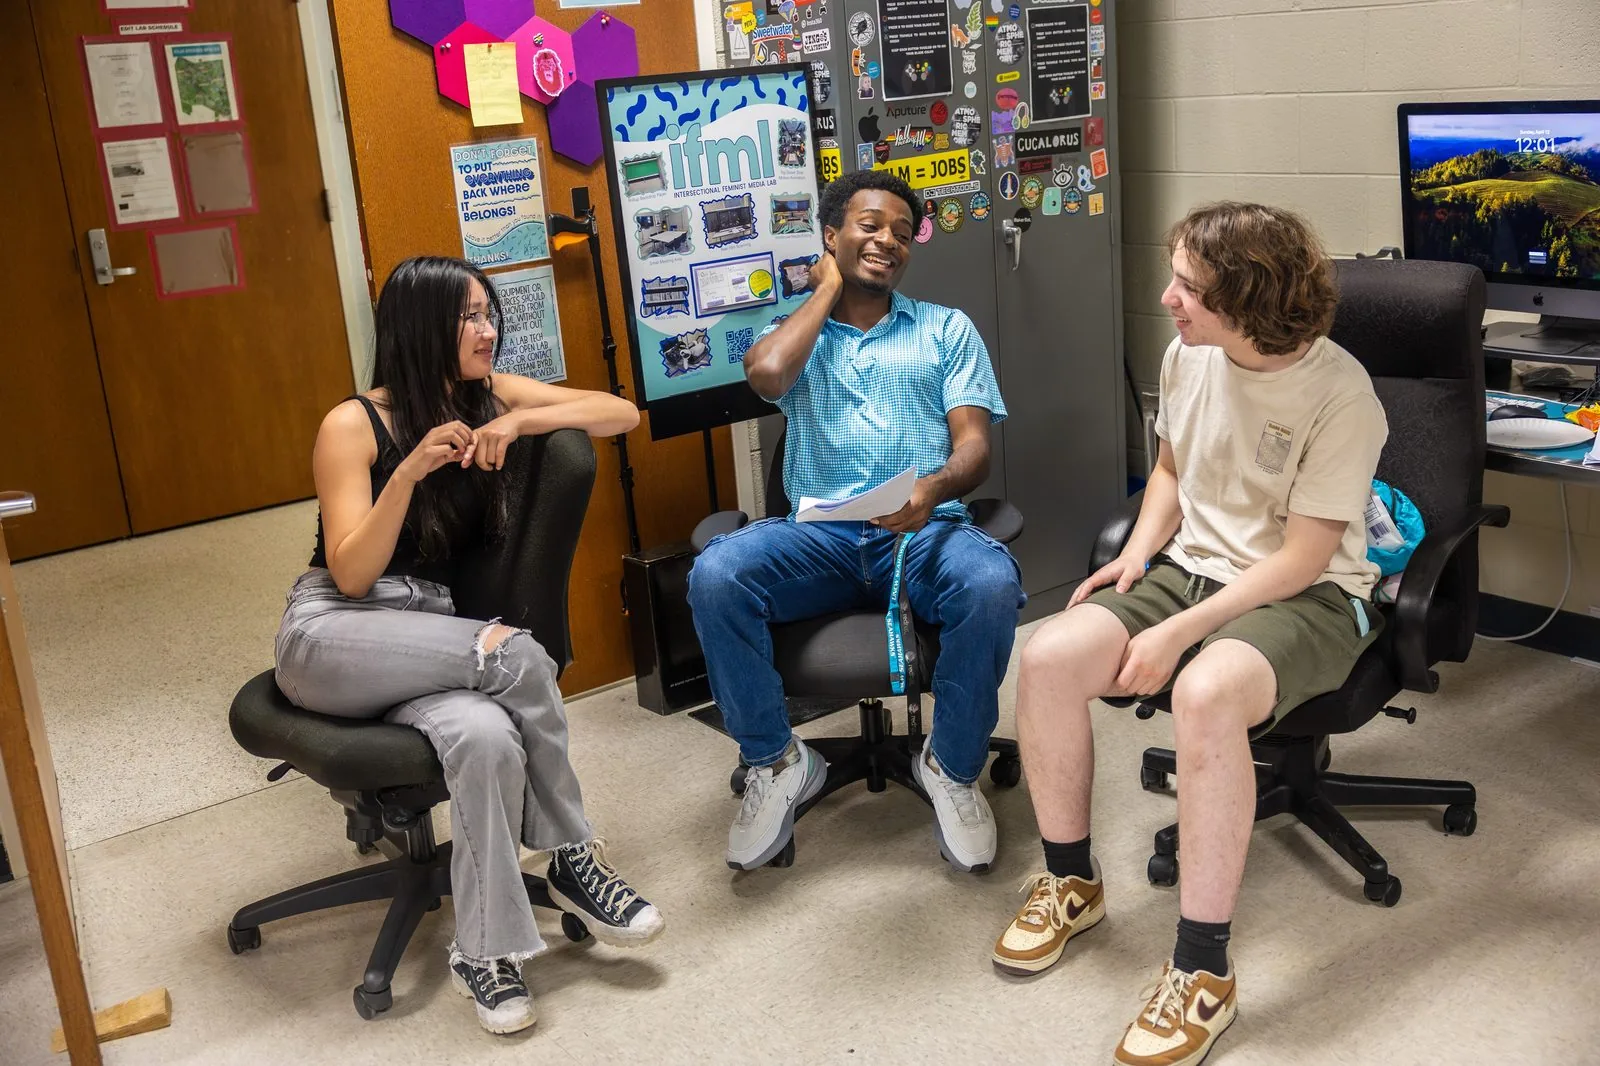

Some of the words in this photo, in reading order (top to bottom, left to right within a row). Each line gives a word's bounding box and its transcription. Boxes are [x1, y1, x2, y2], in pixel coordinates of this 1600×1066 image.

[753, 24, 792, 39] Sweetwater
[886, 104, 926, 118] Aputure
[1017, 132, 1079, 152] CUCALORUS
[1515, 138, 1555, 152] 12:01
[666, 120, 775, 189] ifml
[458, 164, 472, 174] TO
[474, 162, 492, 172] PUT
[930, 156, 966, 179] JOBS
[463, 188, 487, 200] BACK
[674, 187, 720, 198] INTERSECTIONAL
[722, 183, 746, 192] FEMINIST
[461, 202, 470, 211] IT
[498, 285, 530, 298] EQUIPMENT
[532, 283, 542, 292] OR
[501, 296, 520, 306] URCES
[521, 292, 545, 303] SHOULD
[502, 304, 526, 316] EMOVED
[527, 301, 545, 310] FROM
[517, 310, 545, 322] WITHOUT
[530, 319, 543, 329] OUT
[516, 336, 528, 345] LAB
[530, 333, 543, 343] TECH
[500, 347, 517, 357] URING
[519, 344, 535, 354] OPEN
[537, 341, 548, 350] LAB
[496, 357, 514, 367] OURS
[516, 354, 526, 363] OR
[528, 348, 552, 361] CONTACT
[513, 361, 536, 373] STEFANI
[537, 358, 552, 369] BYRD
[895, 540, 908, 577] SEAHAWKS
[888, 618, 896, 657] SEAHAWKS
[897, 633, 905, 673] SEAHAWKS
